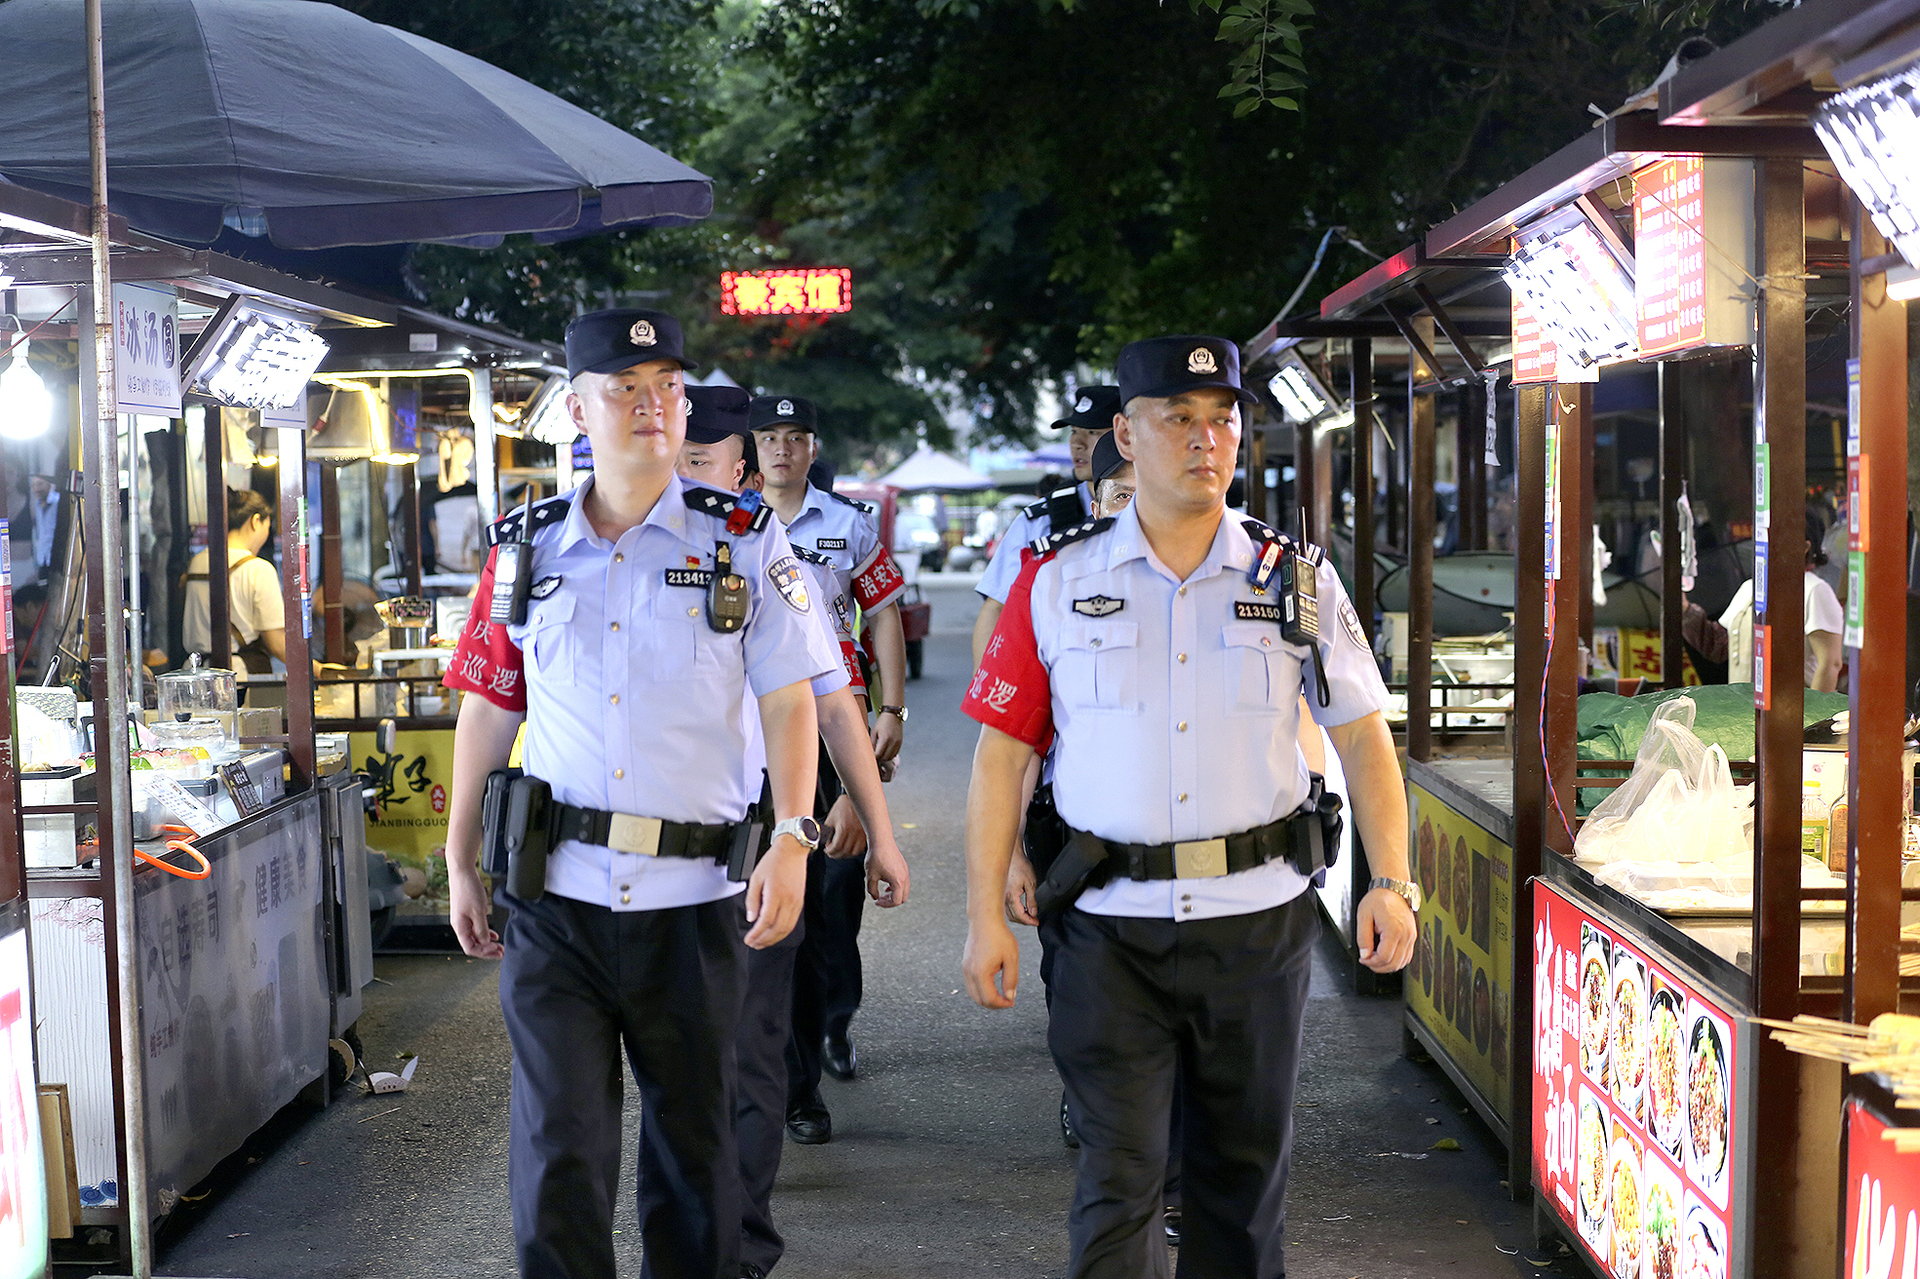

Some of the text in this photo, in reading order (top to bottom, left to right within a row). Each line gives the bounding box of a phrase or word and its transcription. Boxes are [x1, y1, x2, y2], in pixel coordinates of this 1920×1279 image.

[818, 540, 845, 549] F302117
[1238, 605, 1281, 619] 213150
[463, 610, 494, 646] 庆
[255, 845, 307, 919] 健康美食
